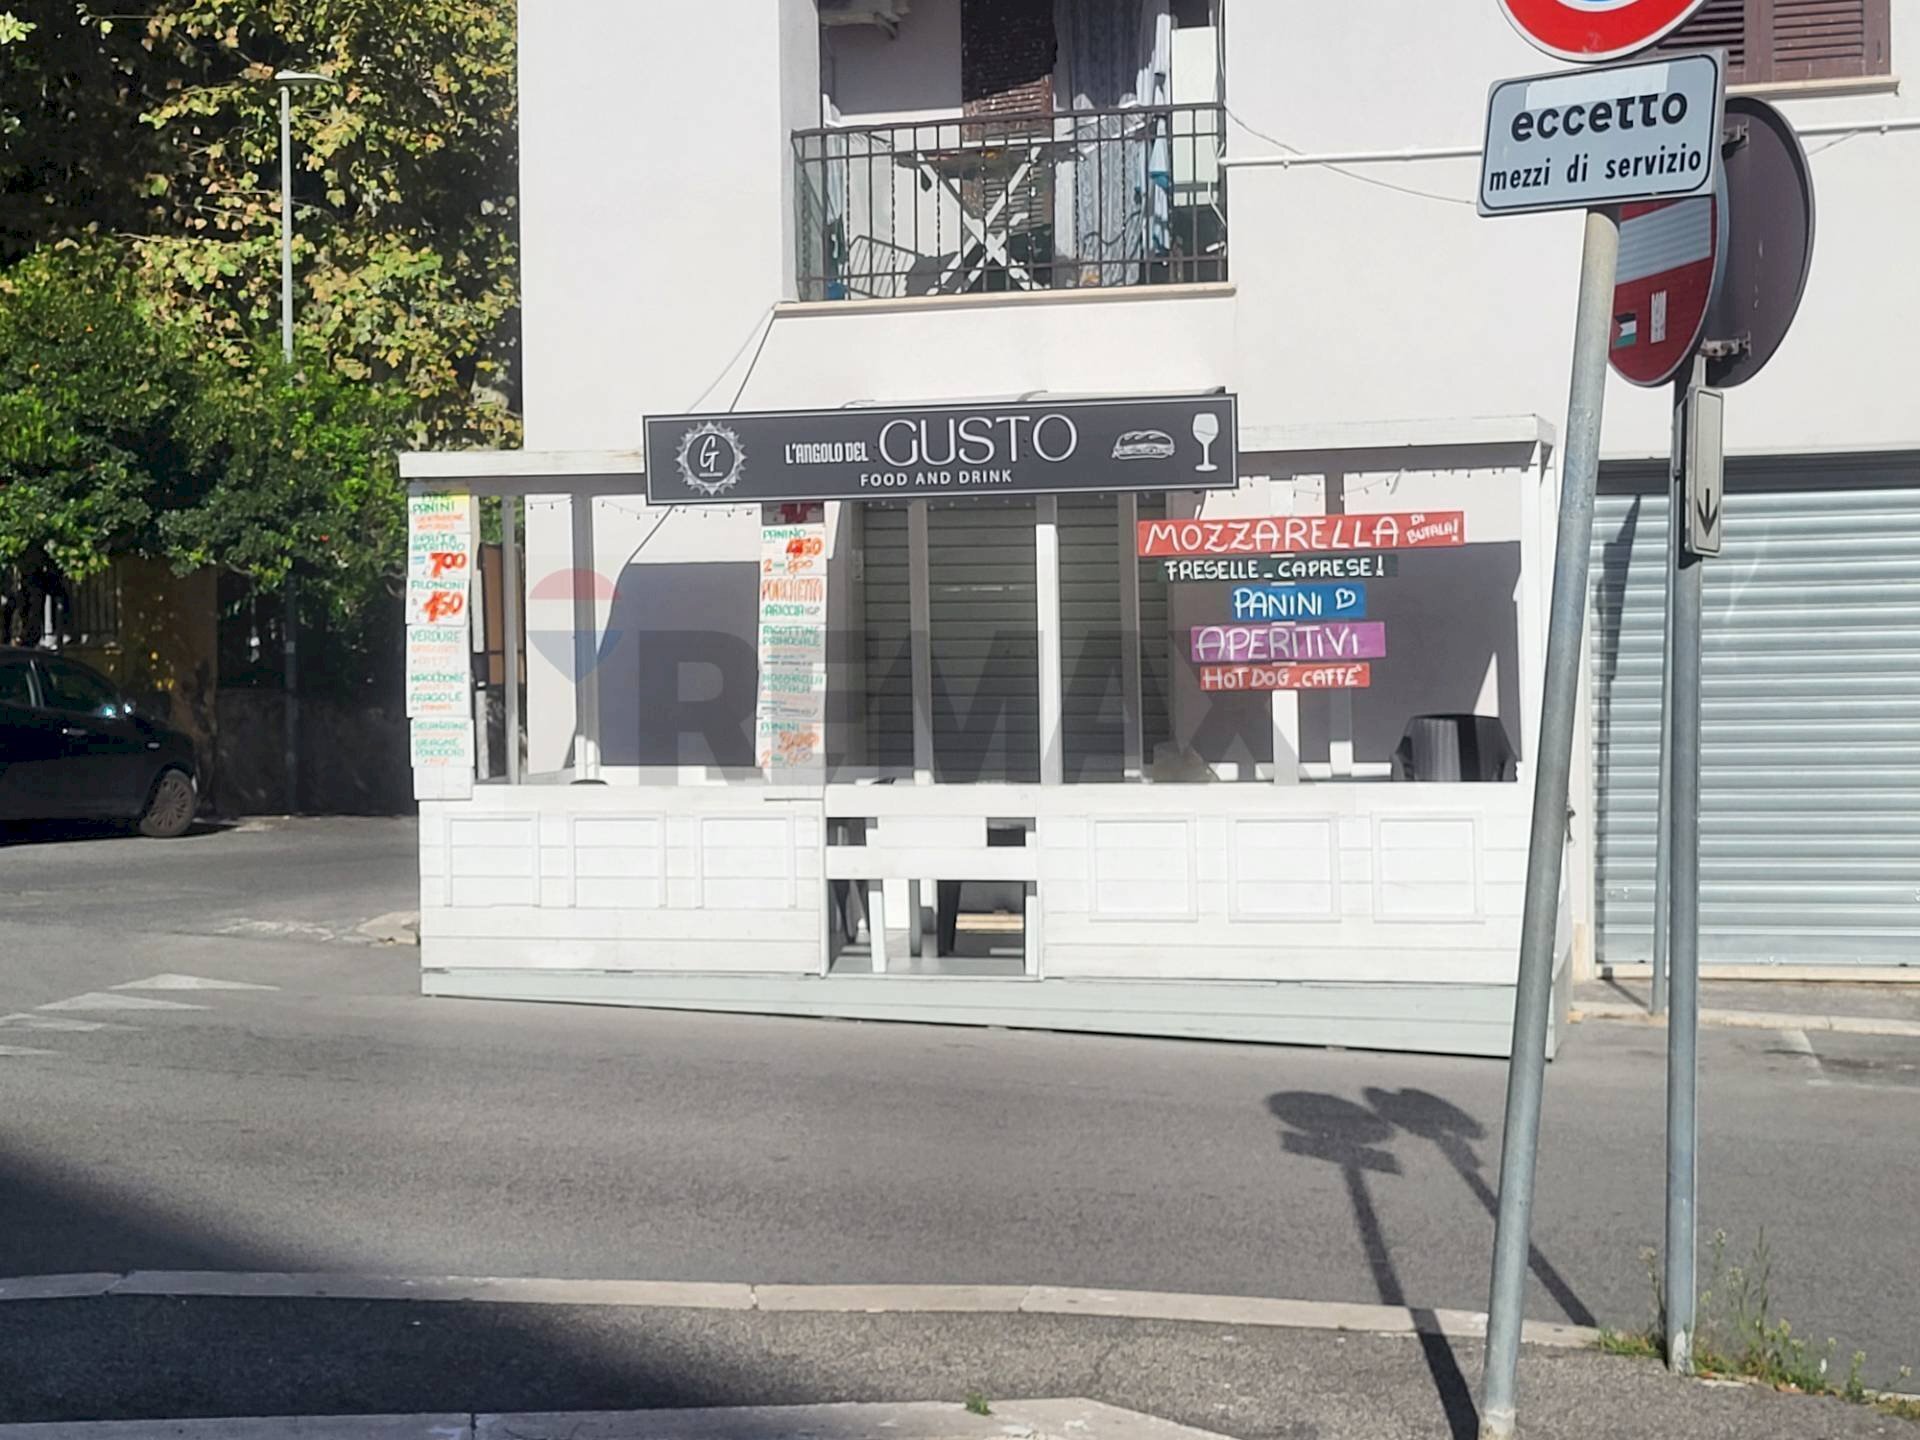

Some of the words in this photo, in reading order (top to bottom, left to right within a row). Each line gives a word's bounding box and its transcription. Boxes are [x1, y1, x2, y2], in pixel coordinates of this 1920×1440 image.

[1511, 92, 1688, 142] eccetto
[1489, 158, 1551, 192] mezzi
[1566, 155, 1588, 184] di
[1605, 143, 1702, 181] servizio
[785, 442, 843, 465] L'ANGOLO
[845, 441, 869, 462] DEL
[878, 413, 1078, 467] GUSTO
[860, 473, 908, 487] FOOD
[915, 471, 951, 485] AND
[958, 469, 1013, 484] DRINK
[1144, 515, 1399, 554] MOZZARELLA
[1165, 560, 1260, 582] FRESELLE
[1233, 586, 1323, 619] PANINI
[1197, 624, 1359, 661] APERITIVI
[1202, 666, 1249, 690] HOT
[1250, 667, 1290, 686] DOG
